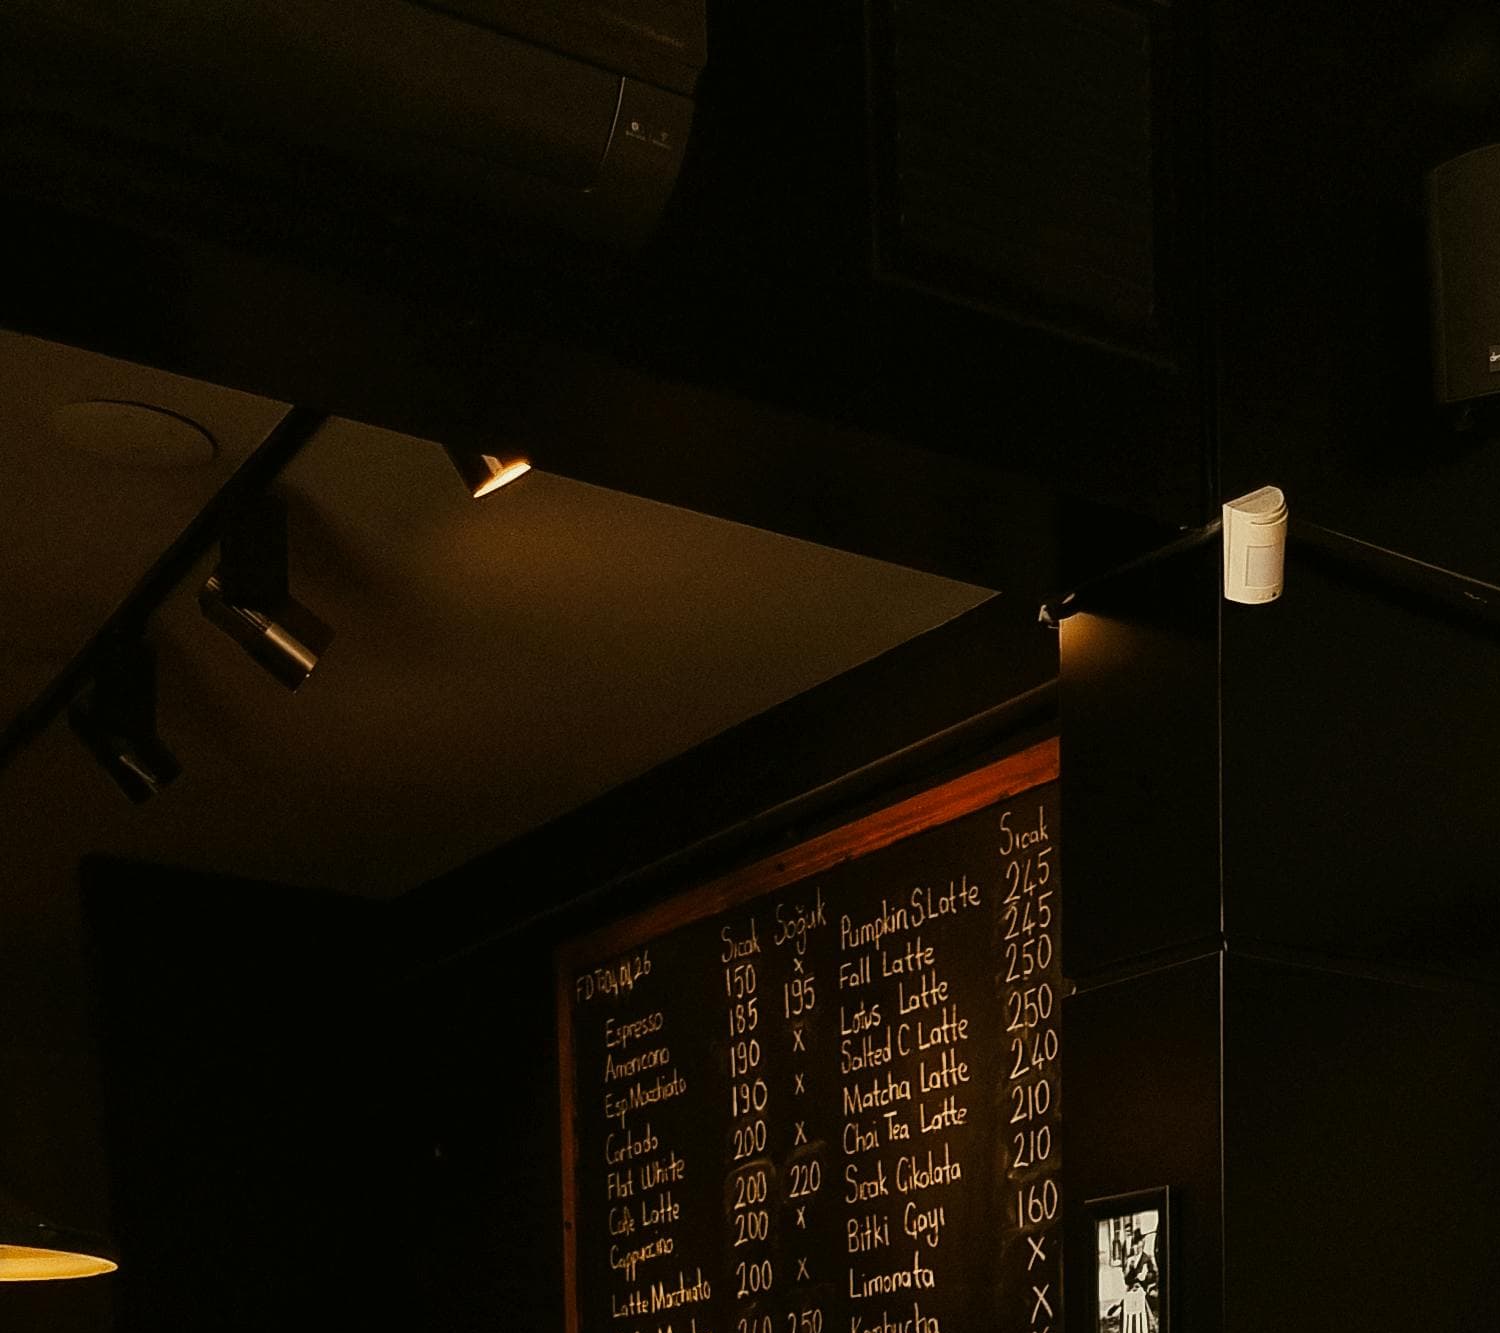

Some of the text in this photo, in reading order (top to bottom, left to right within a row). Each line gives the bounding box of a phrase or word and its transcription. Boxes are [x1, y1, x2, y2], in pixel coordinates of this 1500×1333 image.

[773, 886, 827, 955] Soğuk
[841, 899, 909, 951] Pumpkin
[1003, 847, 1053, 904] 245
[840, 891, 1053, 989] Fall Latte 245
[605, 1012, 663, 1049] Espresso
[726, 964, 756, 999] 150
[841, 933, 1052, 1036] Lotus Latte 250
[604, 976, 816, 1083] Americano 185 195
[731, 1039, 760, 1078] 190
[842, 983, 1053, 1074] Salted C Latte 250
[843, 1029, 1059, 1117] Matcha Latte 240
[606, 1123, 659, 1165] Cortado
[732, 1081, 768, 1118] 190
[843, 1079, 1050, 1155] Chai Tea Latte 210
[1013, 1125, 1051, 1168] 210
[607, 1171, 634, 1201] Flat
[641, 1151, 685, 1190] White
[733, 1120, 767, 1160] 200
[642, 1190, 680, 1226] Latte
[733, 1171, 767, 1210] 200
[789, 1160, 821, 1198] 220
[734, 1210, 769, 1247] 200
[847, 1214, 890, 1254] Bitki
[1018, 1179, 1058, 1229] 160
[612, 1289, 649, 1318] Latte
[735, 1259, 773, 1300] 200
[850, 1250, 935, 1299] Limonata
